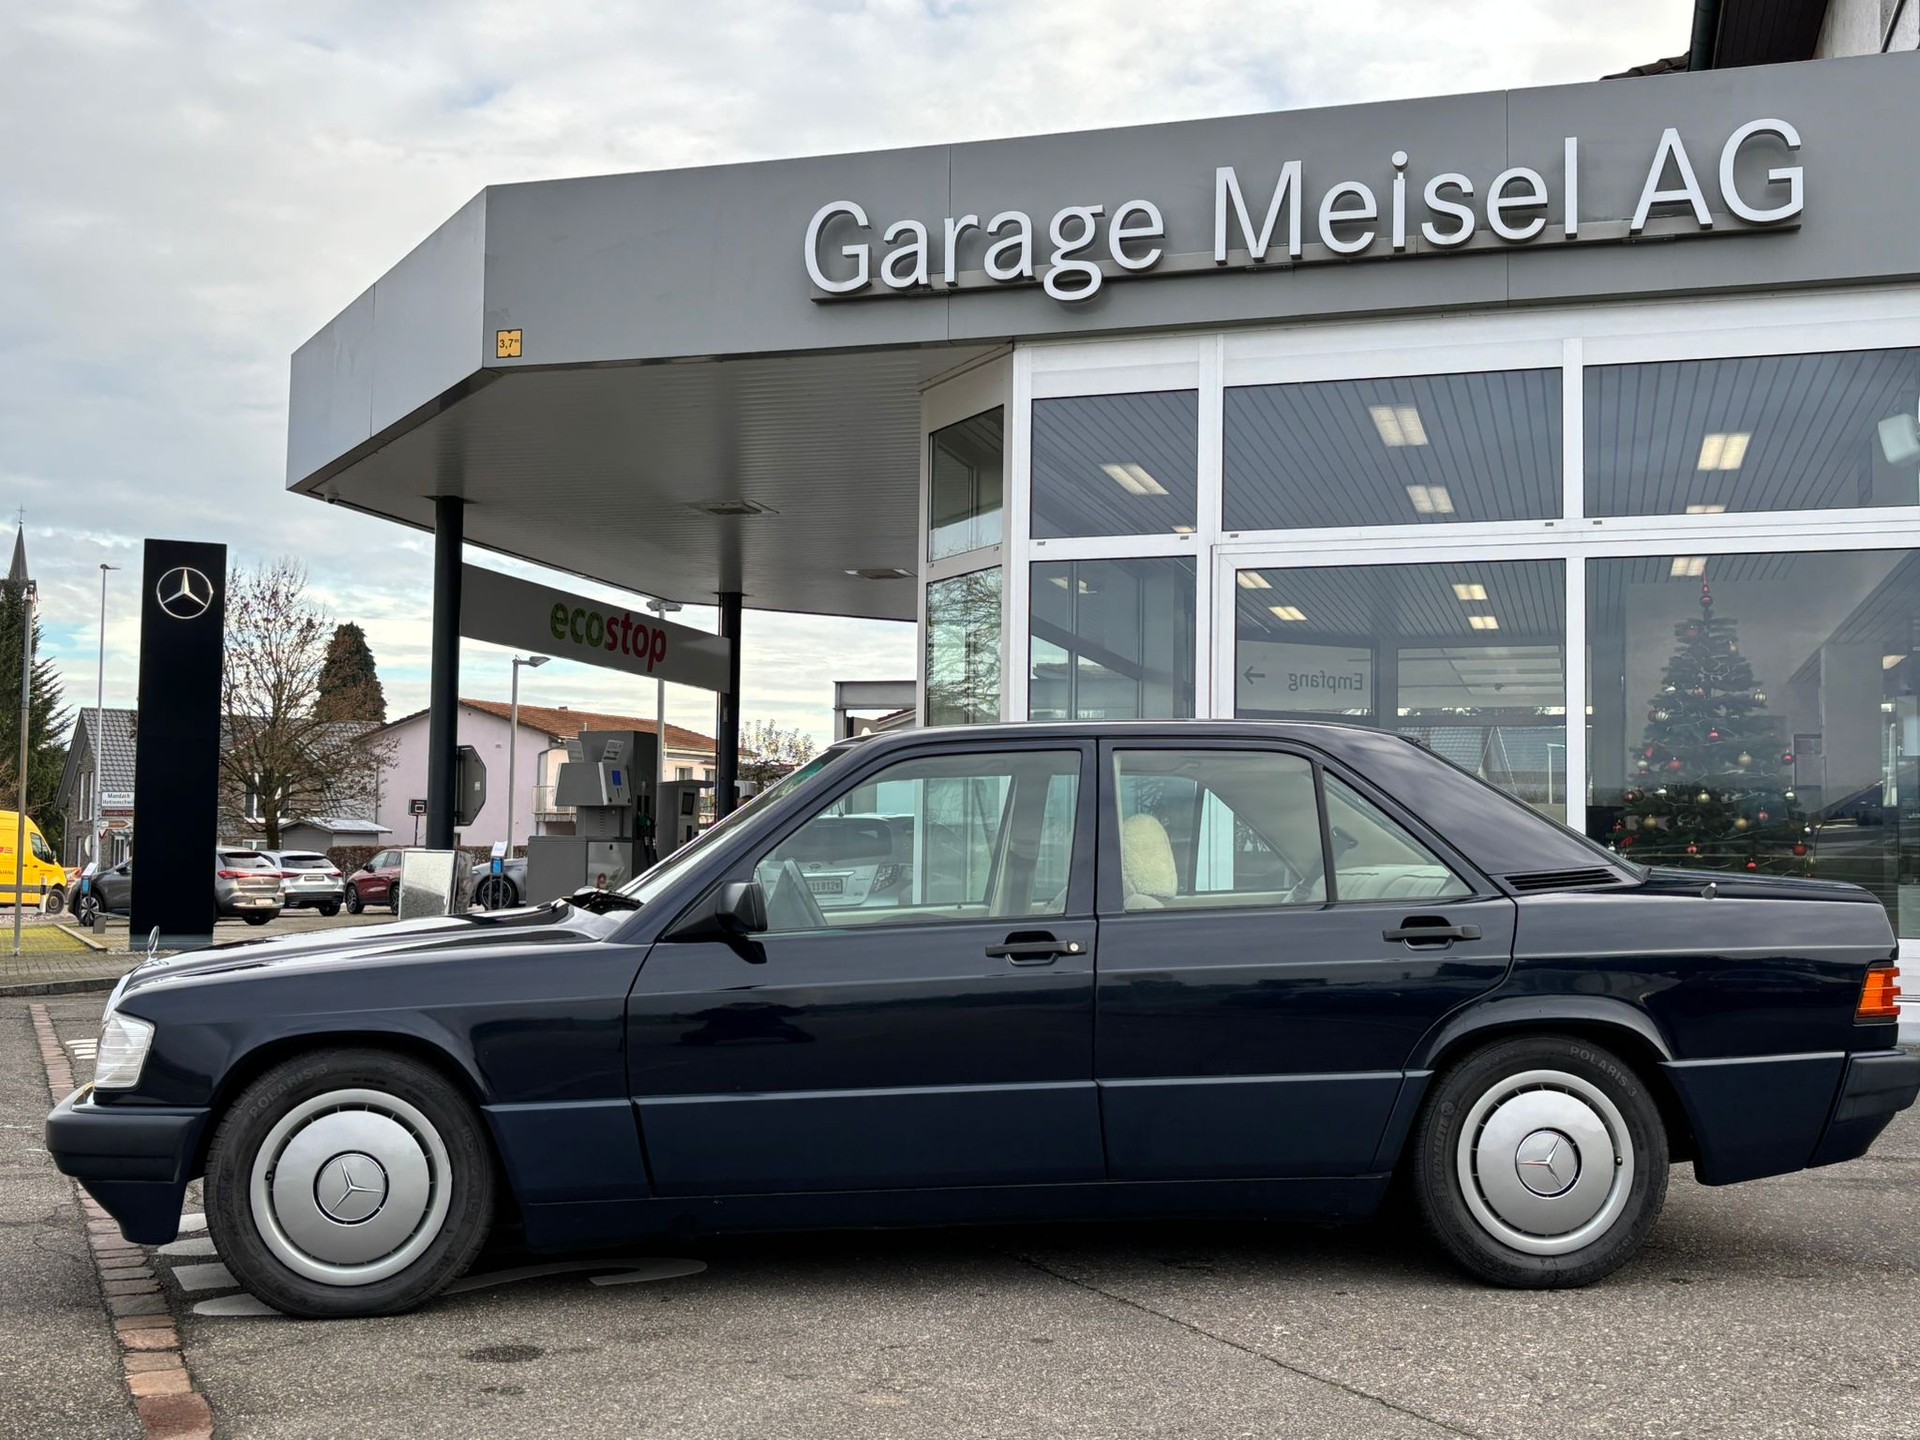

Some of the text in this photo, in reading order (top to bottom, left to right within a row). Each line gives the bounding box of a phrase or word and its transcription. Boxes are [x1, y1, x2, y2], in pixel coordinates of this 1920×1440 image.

[803, 117, 1805, 301] Garage Meisel AG
[550, 602, 667, 672] ecostop
[248, 1063, 328, 1119] POLARIS 3
[1570, 1045, 1637, 1097] POLARIS 3
